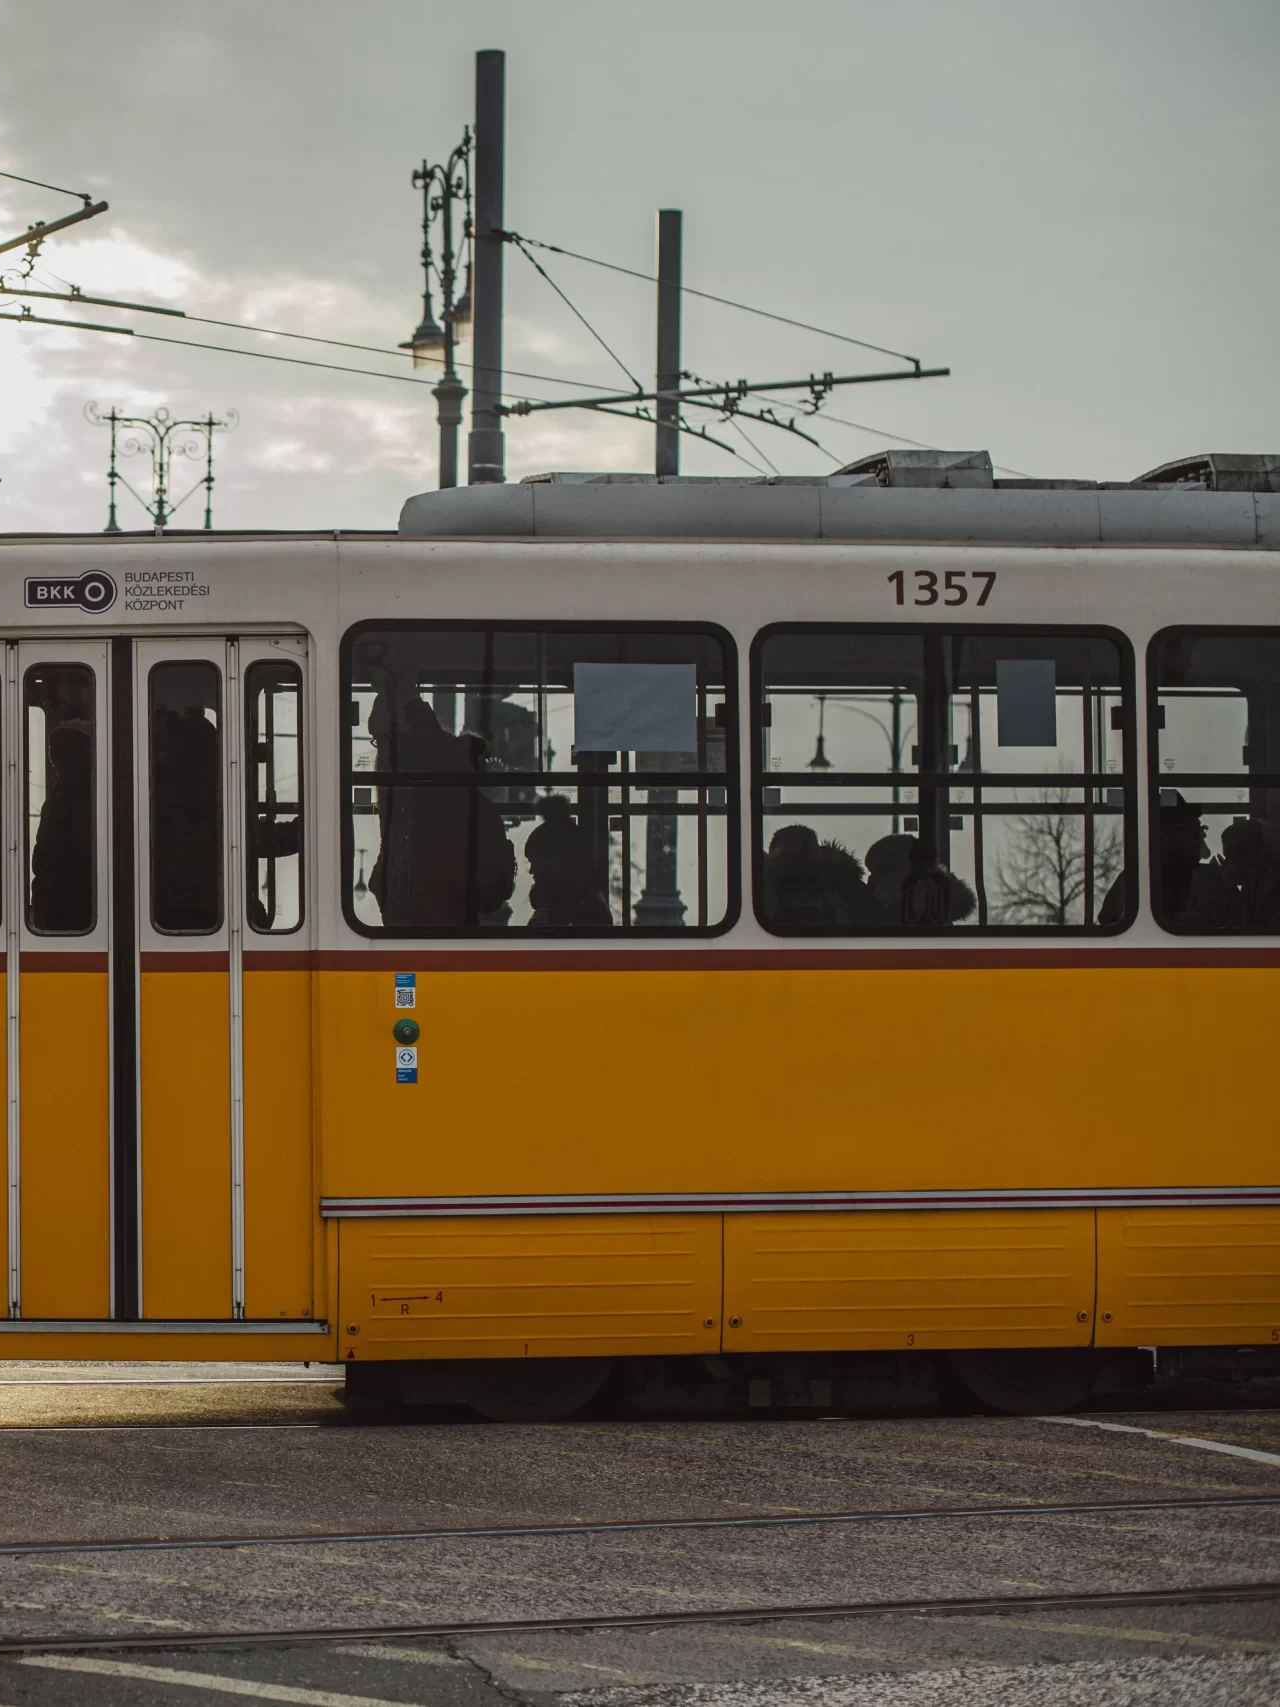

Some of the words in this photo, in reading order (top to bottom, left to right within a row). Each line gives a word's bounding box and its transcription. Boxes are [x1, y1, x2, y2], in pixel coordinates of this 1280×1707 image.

[124, 571, 195, 583] BUDAPESTI
[36, 585, 76, 600] BKK
[124, 583, 210, 597] KÖZLEKEDÉSI
[886, 569, 997, 606] 1357
[124, 597, 185, 611] KÖZPONT
[370, 1293, 376, 1307] 1
[434, 1290, 444, 1304] 4
[400, 1303, 410, 1315] R
[906, 1333, 915, 1346] 3
